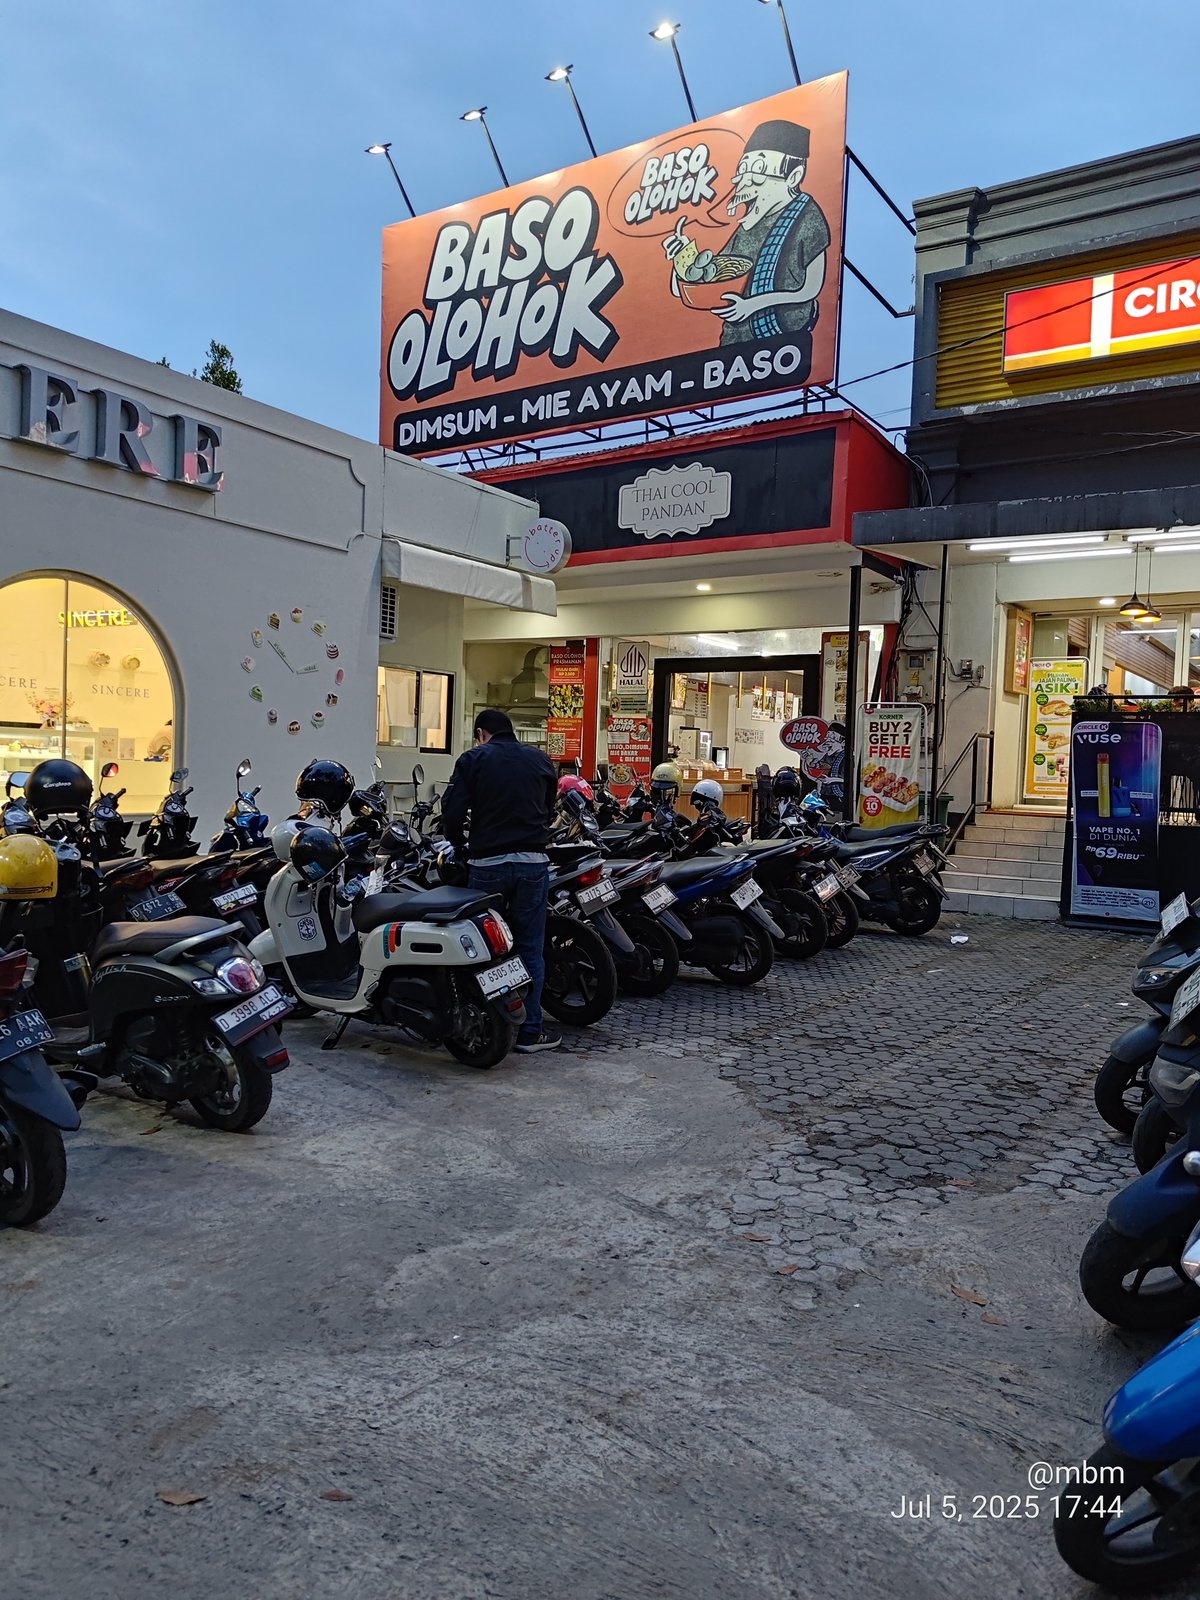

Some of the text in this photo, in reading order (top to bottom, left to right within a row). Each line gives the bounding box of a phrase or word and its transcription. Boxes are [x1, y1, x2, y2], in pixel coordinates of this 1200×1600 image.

[641, 143, 710, 185] BASO
[624, 166, 720, 225] OLOHOK
[424, 188, 595, 302] BASO
[1124, 278, 1200, 319] CIR
[388, 256, 621, 394] OLOHOK
[399, 404, 498, 447] DIMSUM
[521, 390, 571, 428] MIE
[577, 370, 674, 414] AYAM
[703, 344, 802, 391] BASO
[631, 479, 717, 504] THAI COOL
[641, 500, 707, 521] PANDAN
[58, 609, 131, 628] SINCERE
[91, 683, 151, 699] SINCERE
[1034, 682, 1071, 694] ASIK
[607, 723, 637, 732] OLOHOK
[792, 722, 819, 734] BASO
[869, 721, 912, 733] BUY 2
[785, 730, 822, 744] OLOHOK
[868, 733, 909, 745] GET 1
[868, 745, 911, 758] FREE
[866, 802, 878, 811] 10
[1089, 826, 1114, 834] VAPE
[1116, 827, 1134, 835] NO.
[585, 886, 602, 901] 3175
[132, 909, 140, 918] D
[478, 960, 524, 987] D 6505 AEX
[218, 988, 279, 1030] D 3998 ACJ
[15, 1011, 45, 1032] AAK
